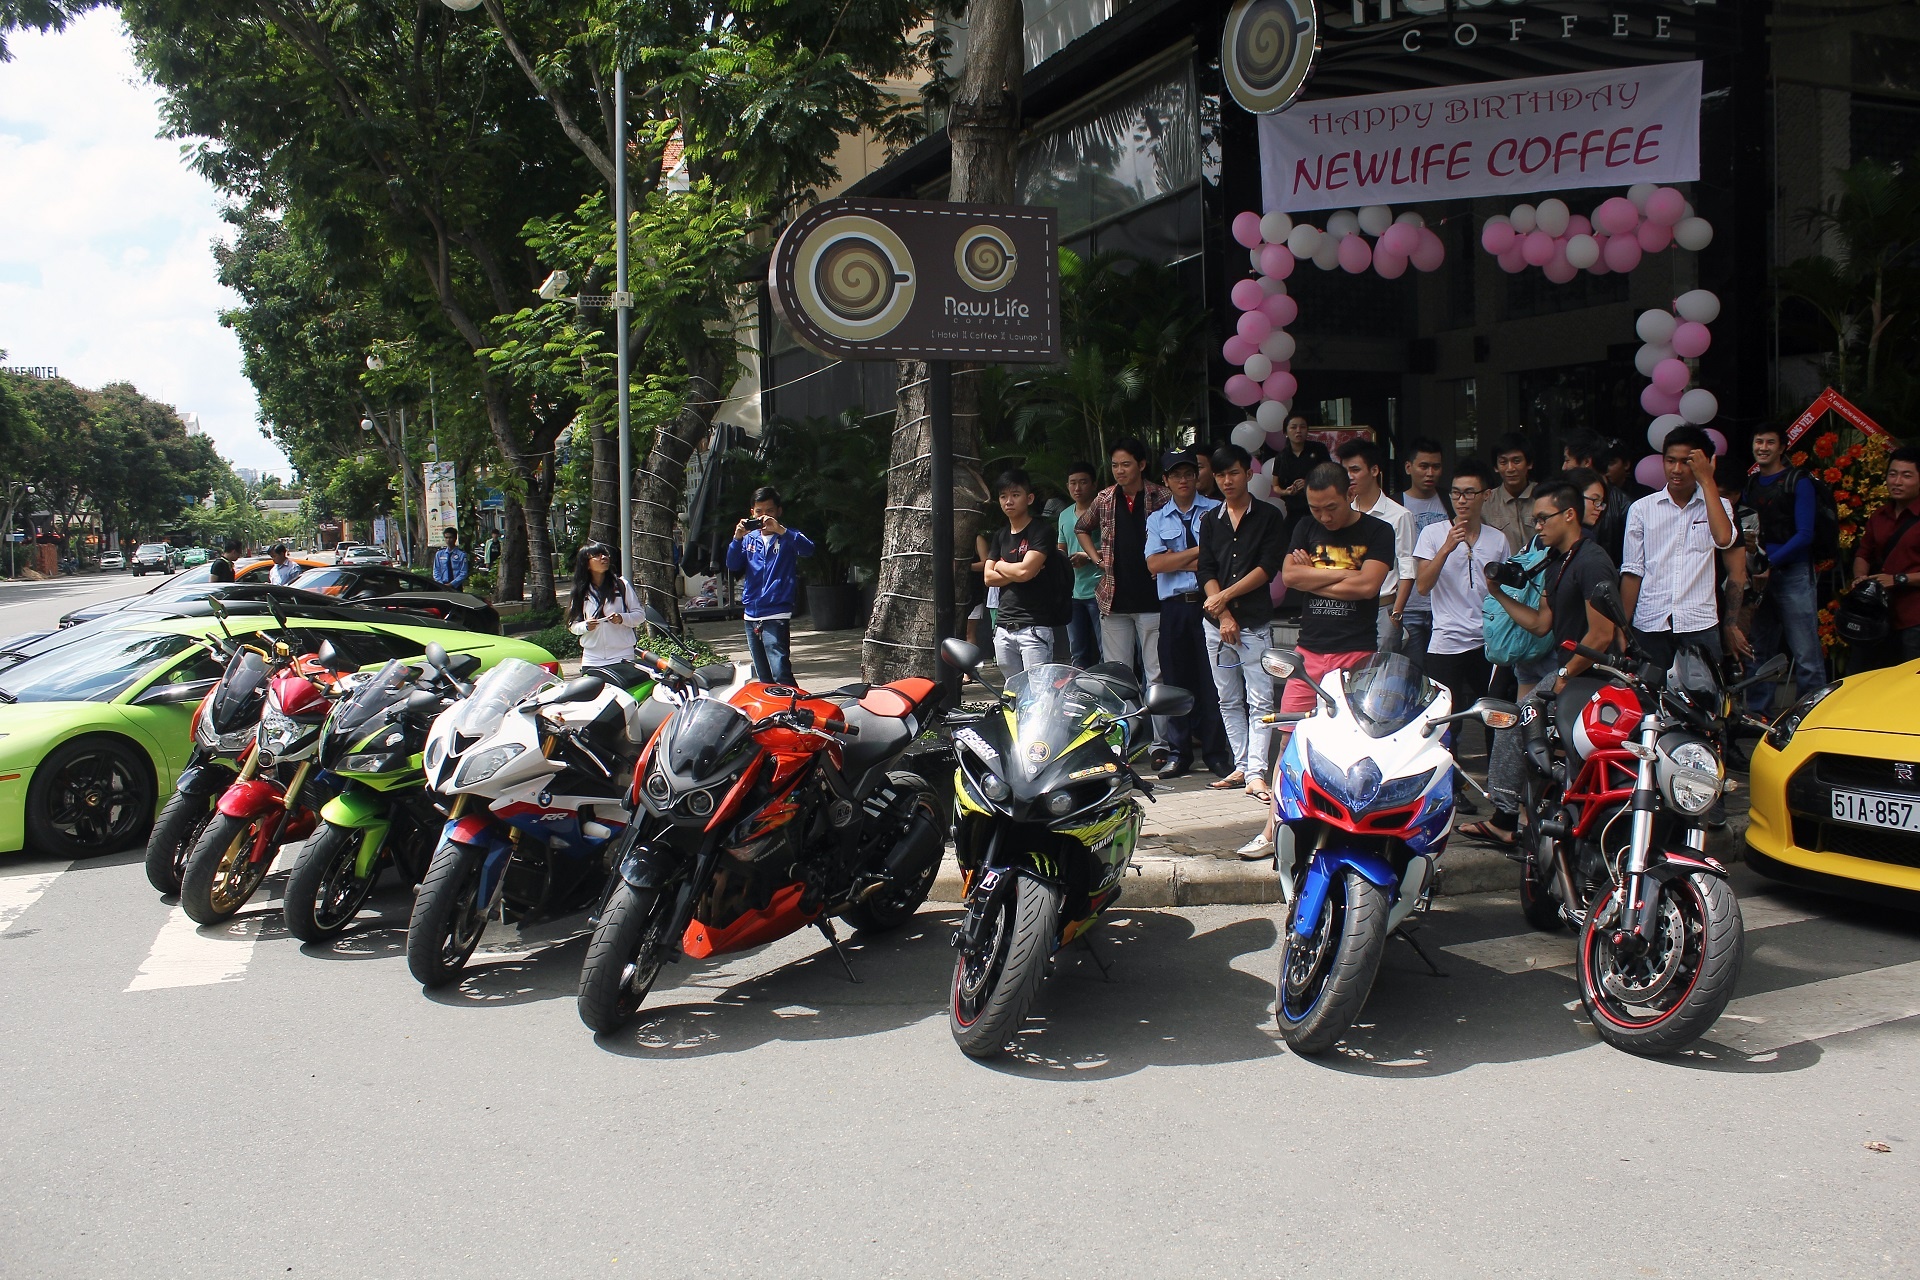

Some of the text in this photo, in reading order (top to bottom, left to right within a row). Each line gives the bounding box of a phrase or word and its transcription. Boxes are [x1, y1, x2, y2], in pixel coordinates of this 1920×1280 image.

[1402, 14, 1671, 52] COFFEE
[1308, 82, 1641, 136] HAPPY BIRTHDAY
[1293, 124, 1663, 195] NEWLIFE COFFEE
[944, 296, 1030, 318] New Life
[937, 331, 1038, 342] Hotel Coffee Lounge
[1787, 424, 1803, 440] LONG
[754, 839, 786, 862] Kawasaki
[1091, 833, 1114, 853] YAMAHA
